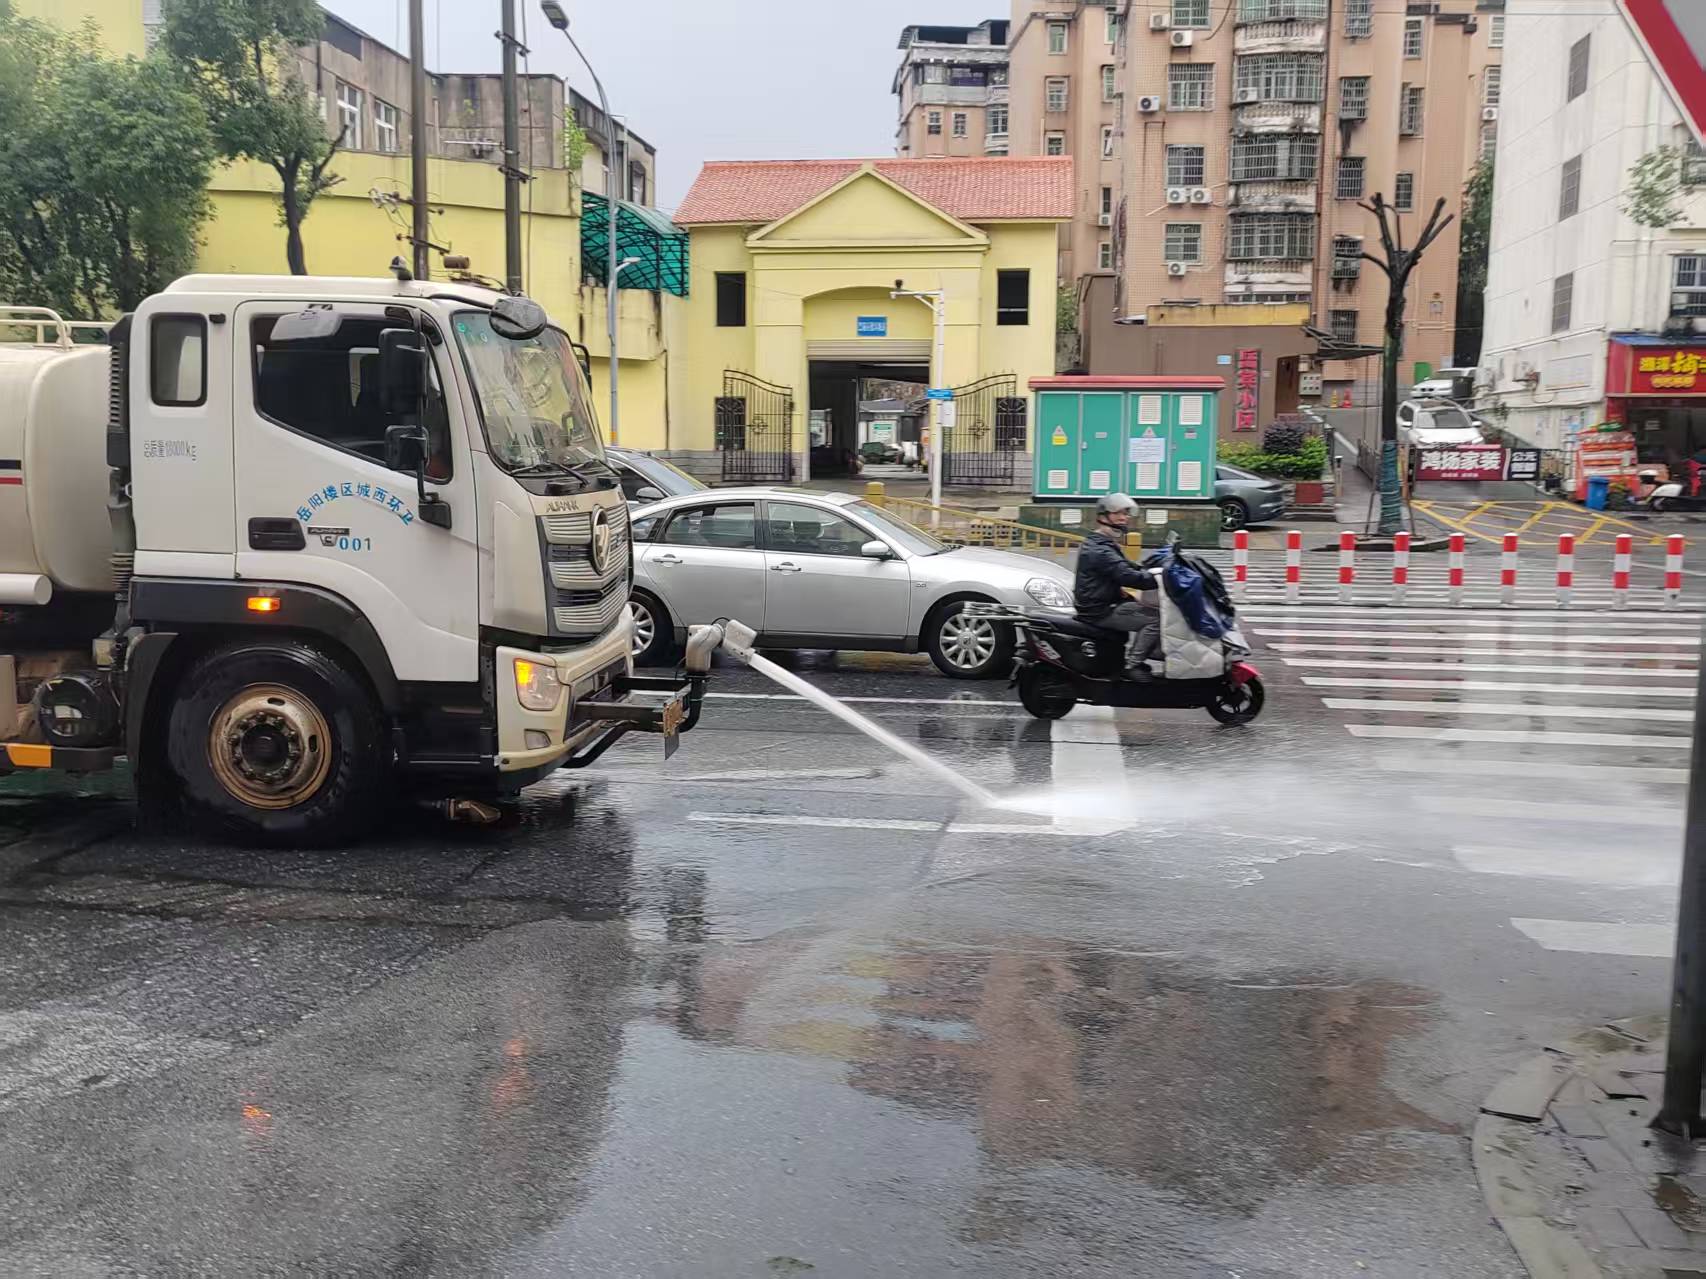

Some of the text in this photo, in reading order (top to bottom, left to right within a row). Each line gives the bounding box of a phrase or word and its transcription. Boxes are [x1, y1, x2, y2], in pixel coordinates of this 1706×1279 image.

[1420, 450, 1501, 470] 鸿扬家装
[296, 482, 415, 526] 岳阳楼区城西环卫
[339, 536, 371, 552] 001
